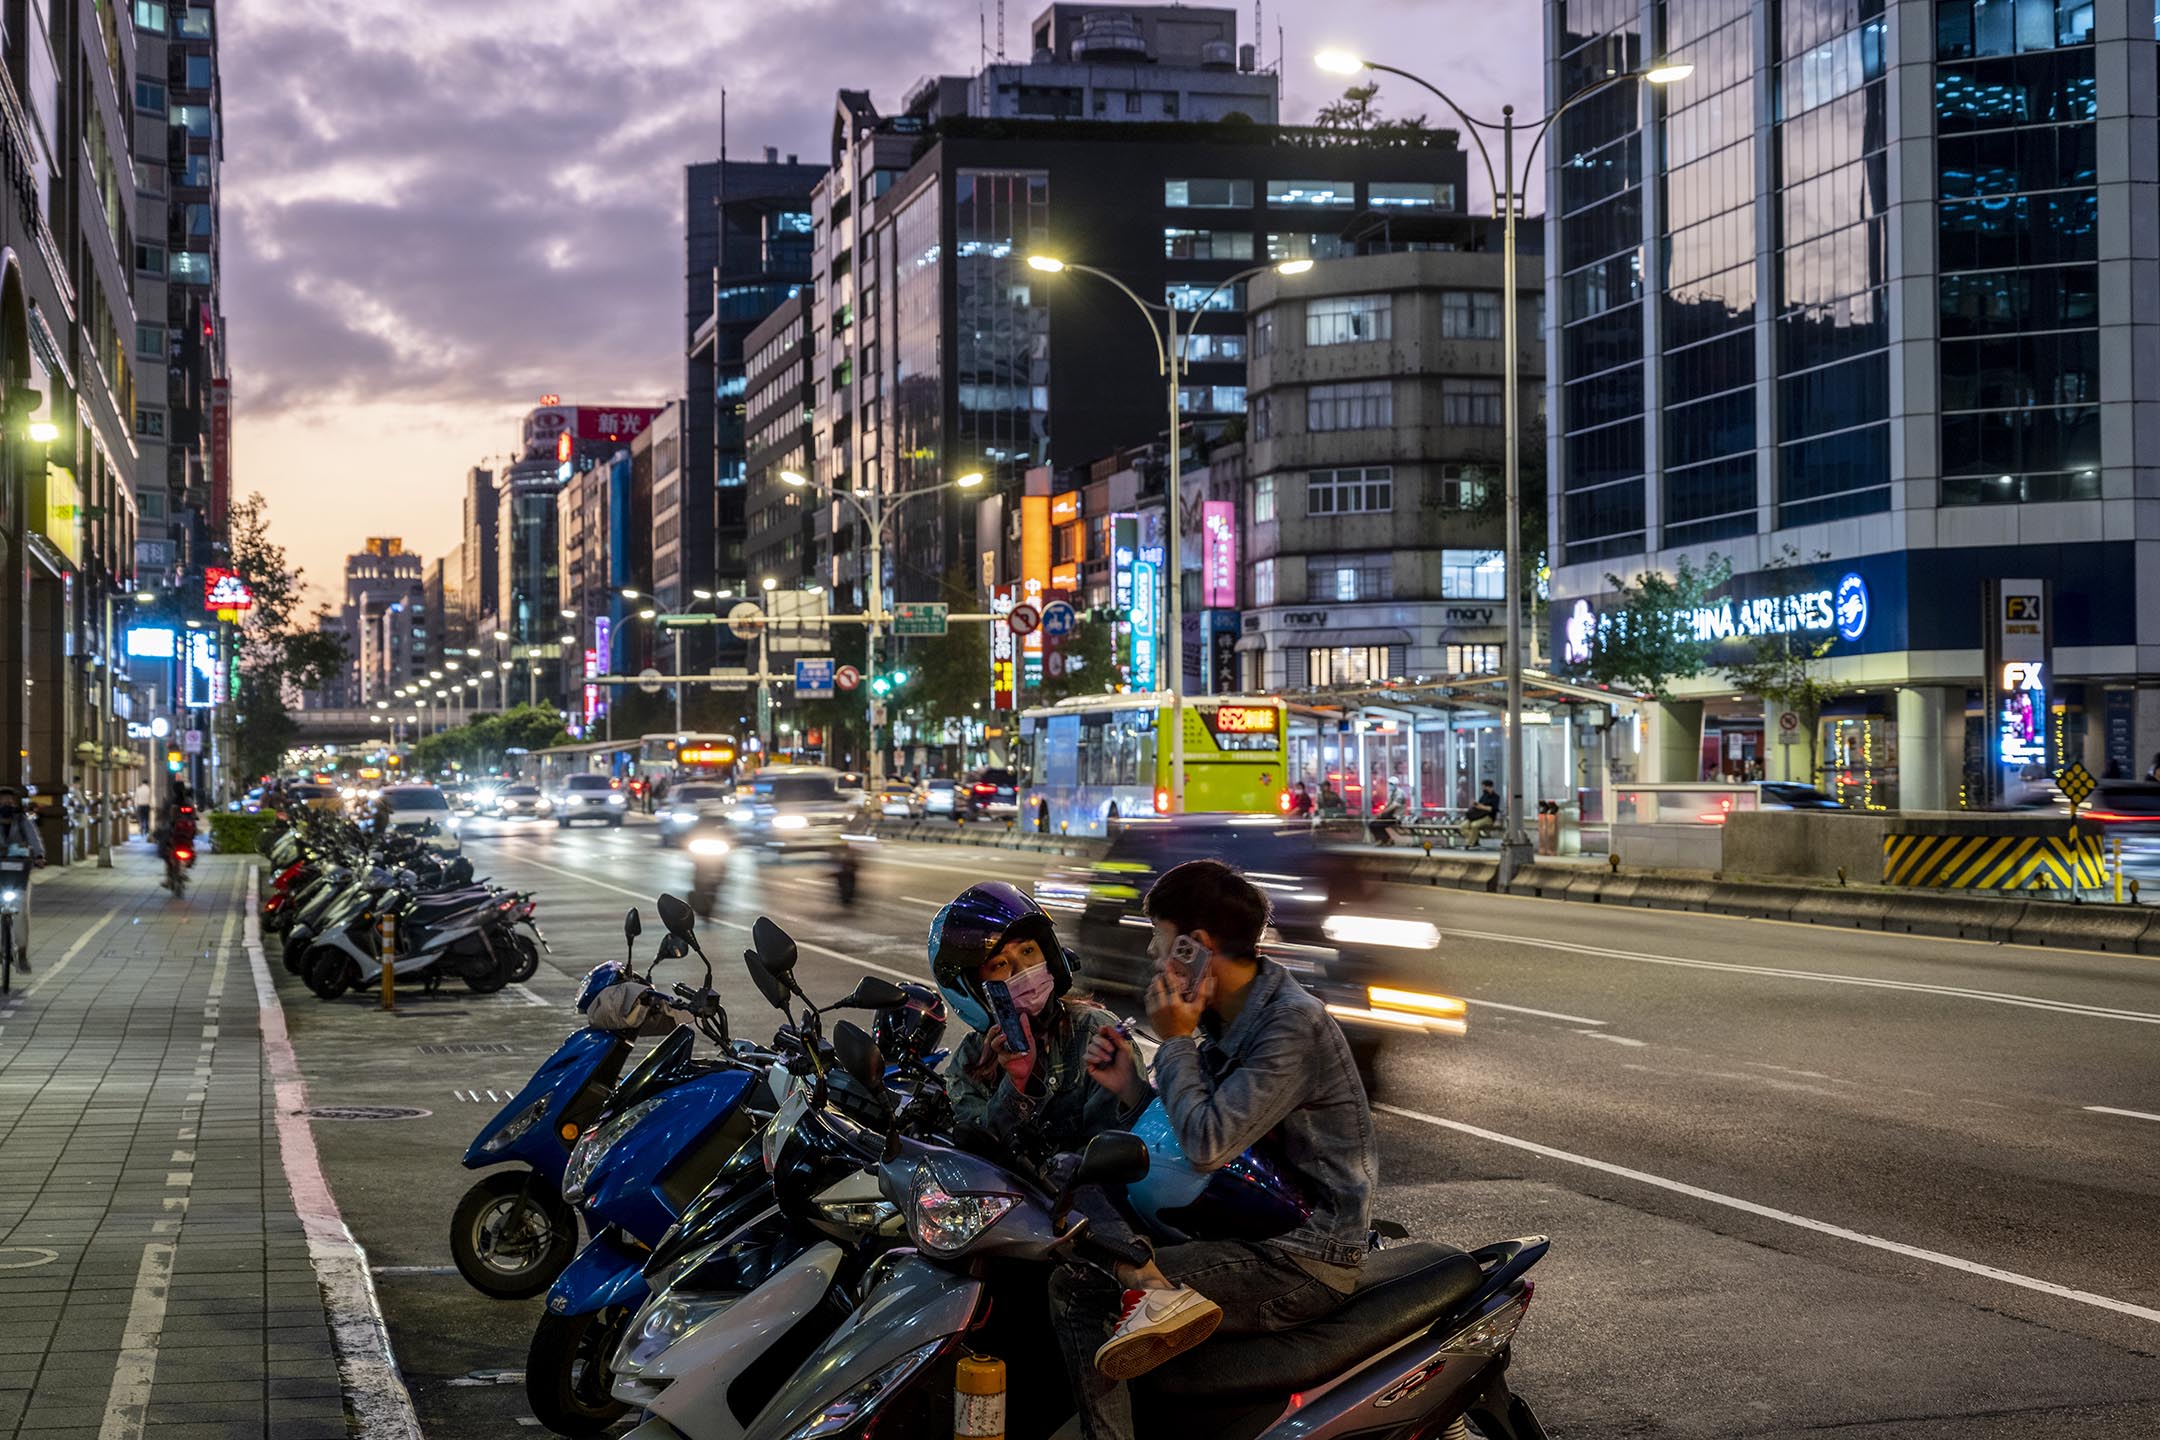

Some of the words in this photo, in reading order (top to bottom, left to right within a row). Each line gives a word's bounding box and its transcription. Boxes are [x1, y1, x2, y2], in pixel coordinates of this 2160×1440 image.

[599, 413, 655, 434] 新光
[1283, 611, 1327, 626] mary
[1446, 607, 1493, 625] mary
[1673, 602, 1737, 643] CHINA
[1738, 590, 1833, 637] AIRLINES
[2008, 598, 2038, 618] FX
[2004, 663, 2043, 690] FX
[1219, 708, 1246, 731] 652
